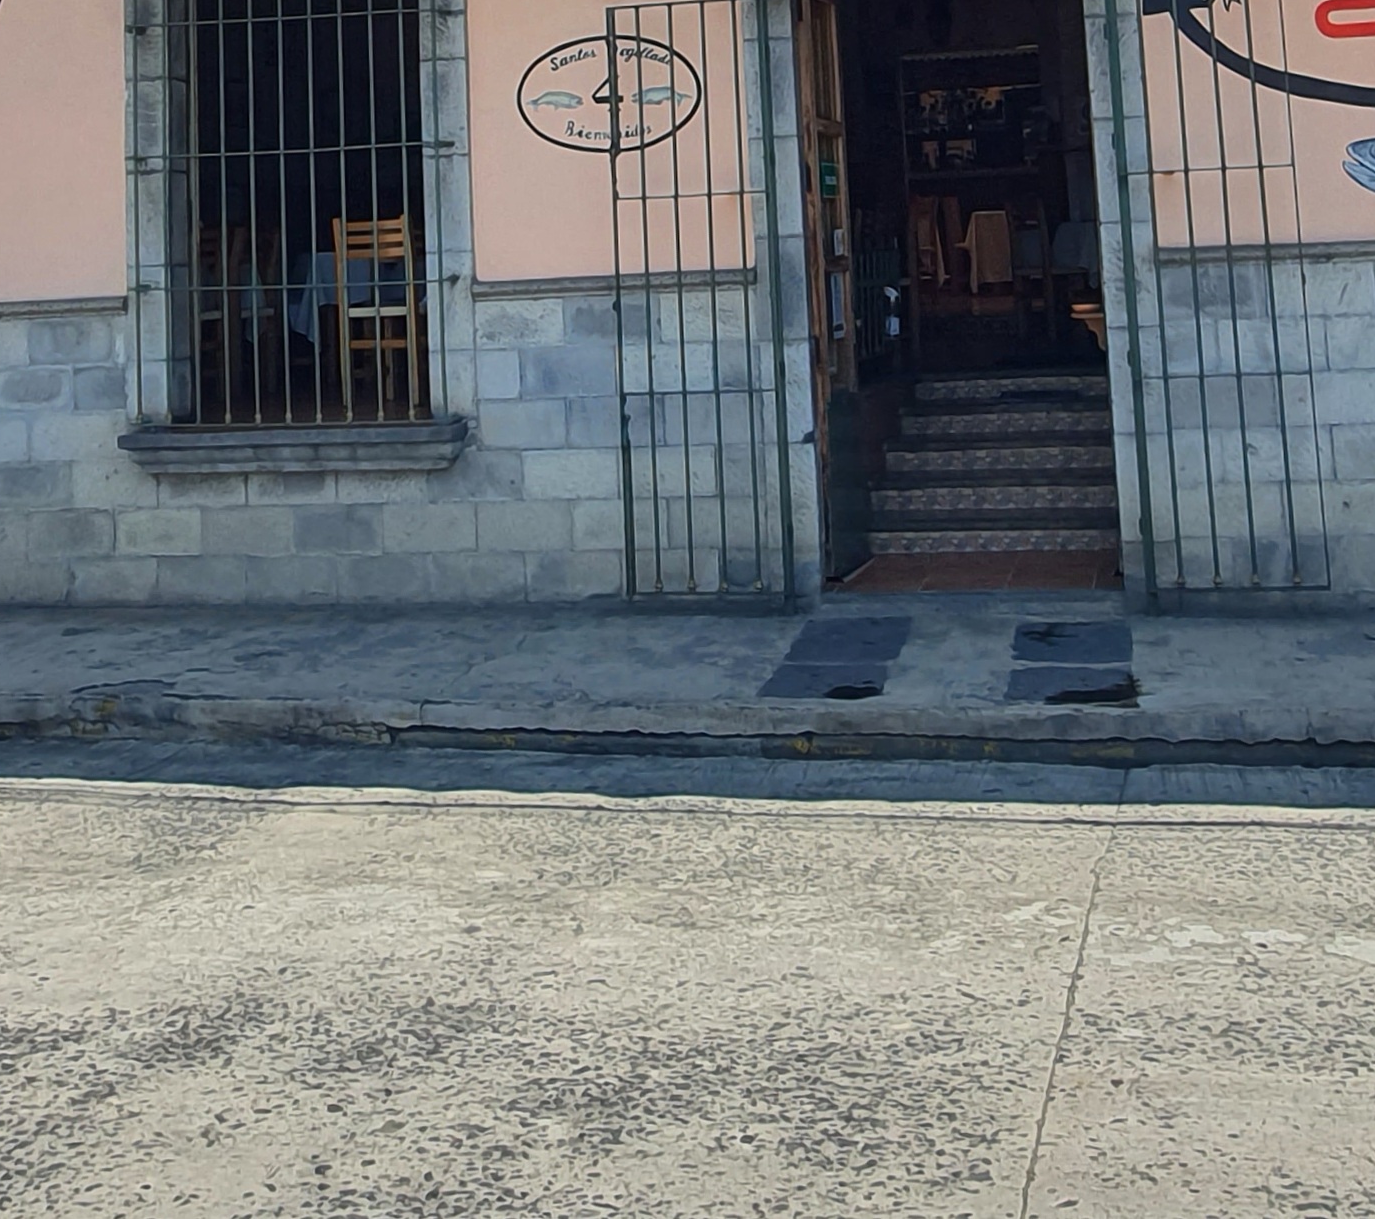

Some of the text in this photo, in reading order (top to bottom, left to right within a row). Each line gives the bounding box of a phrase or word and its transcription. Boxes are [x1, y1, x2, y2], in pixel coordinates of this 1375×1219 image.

[550, 46, 673, 72] Santos egllad
[564, 120, 652, 141] Bienvids
